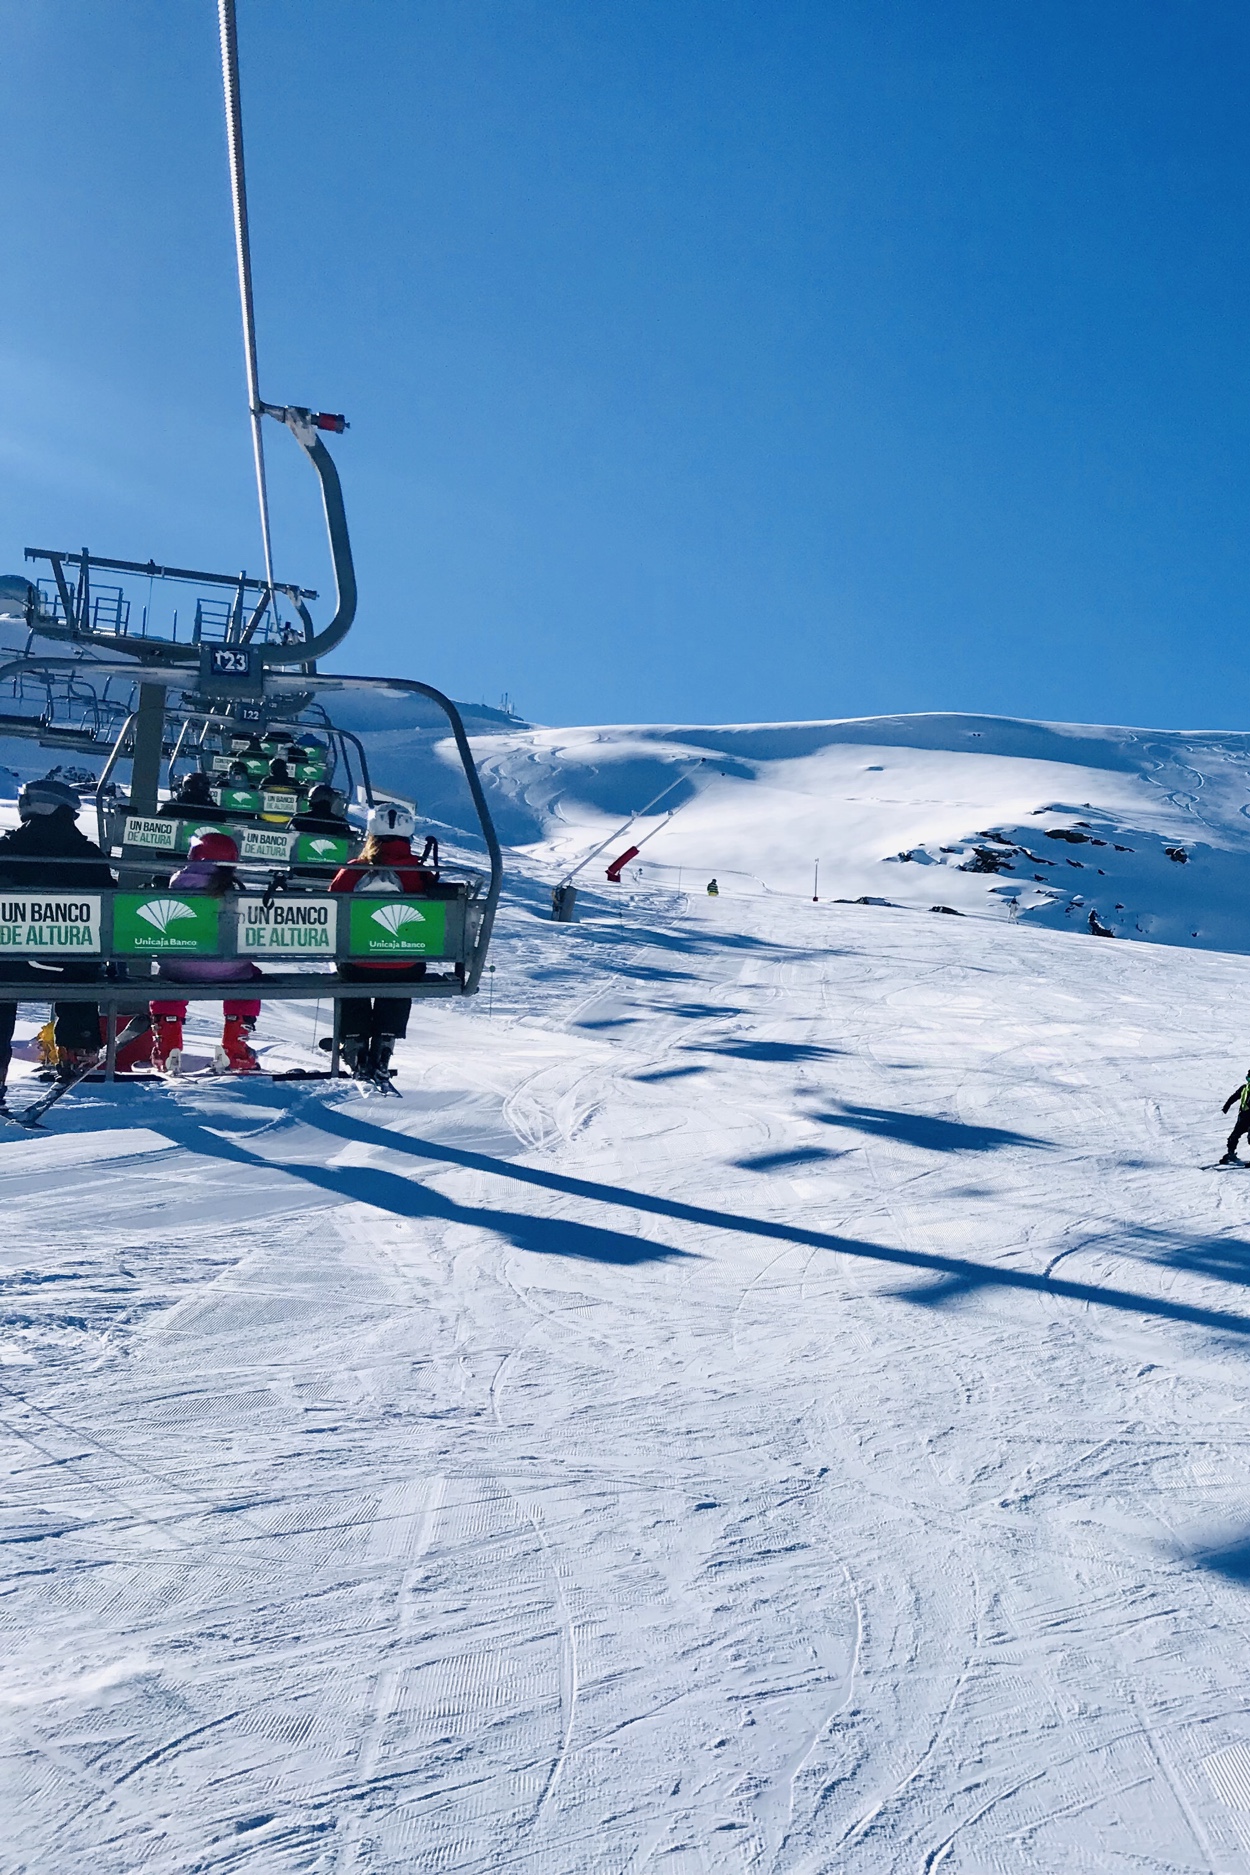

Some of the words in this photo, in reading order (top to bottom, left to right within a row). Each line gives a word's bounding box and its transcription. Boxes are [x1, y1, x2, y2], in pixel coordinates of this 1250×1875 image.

[215, 651, 246, 671] 123
[243, 709, 259, 720] 122
[129, 820, 142, 833] UN
[143, 821, 173, 834] BANCO
[127, 831, 139, 842] DE
[139, 832, 172, 845] ALTURA
[247, 833, 259, 844] UN
[260, 834, 287, 846] BANCO
[245, 843, 257, 854] DE
[257, 844, 287, 857] ALTURA
[1, 902, 26, 923] UN
[31, 902, 91, 922] BANCO
[247, 906, 270, 925] UN
[273, 906, 328, 925] BANCO
[0, 925, 22, 946] DE
[26, 925, 93, 946] ALTURA
[134, 937, 169, 948] Unicaja
[170, 938, 197, 946] Banco
[245, 927, 266, 947] DE
[269, 928, 330, 947] ALTURA
[369, 940, 401, 949] Unicaja
